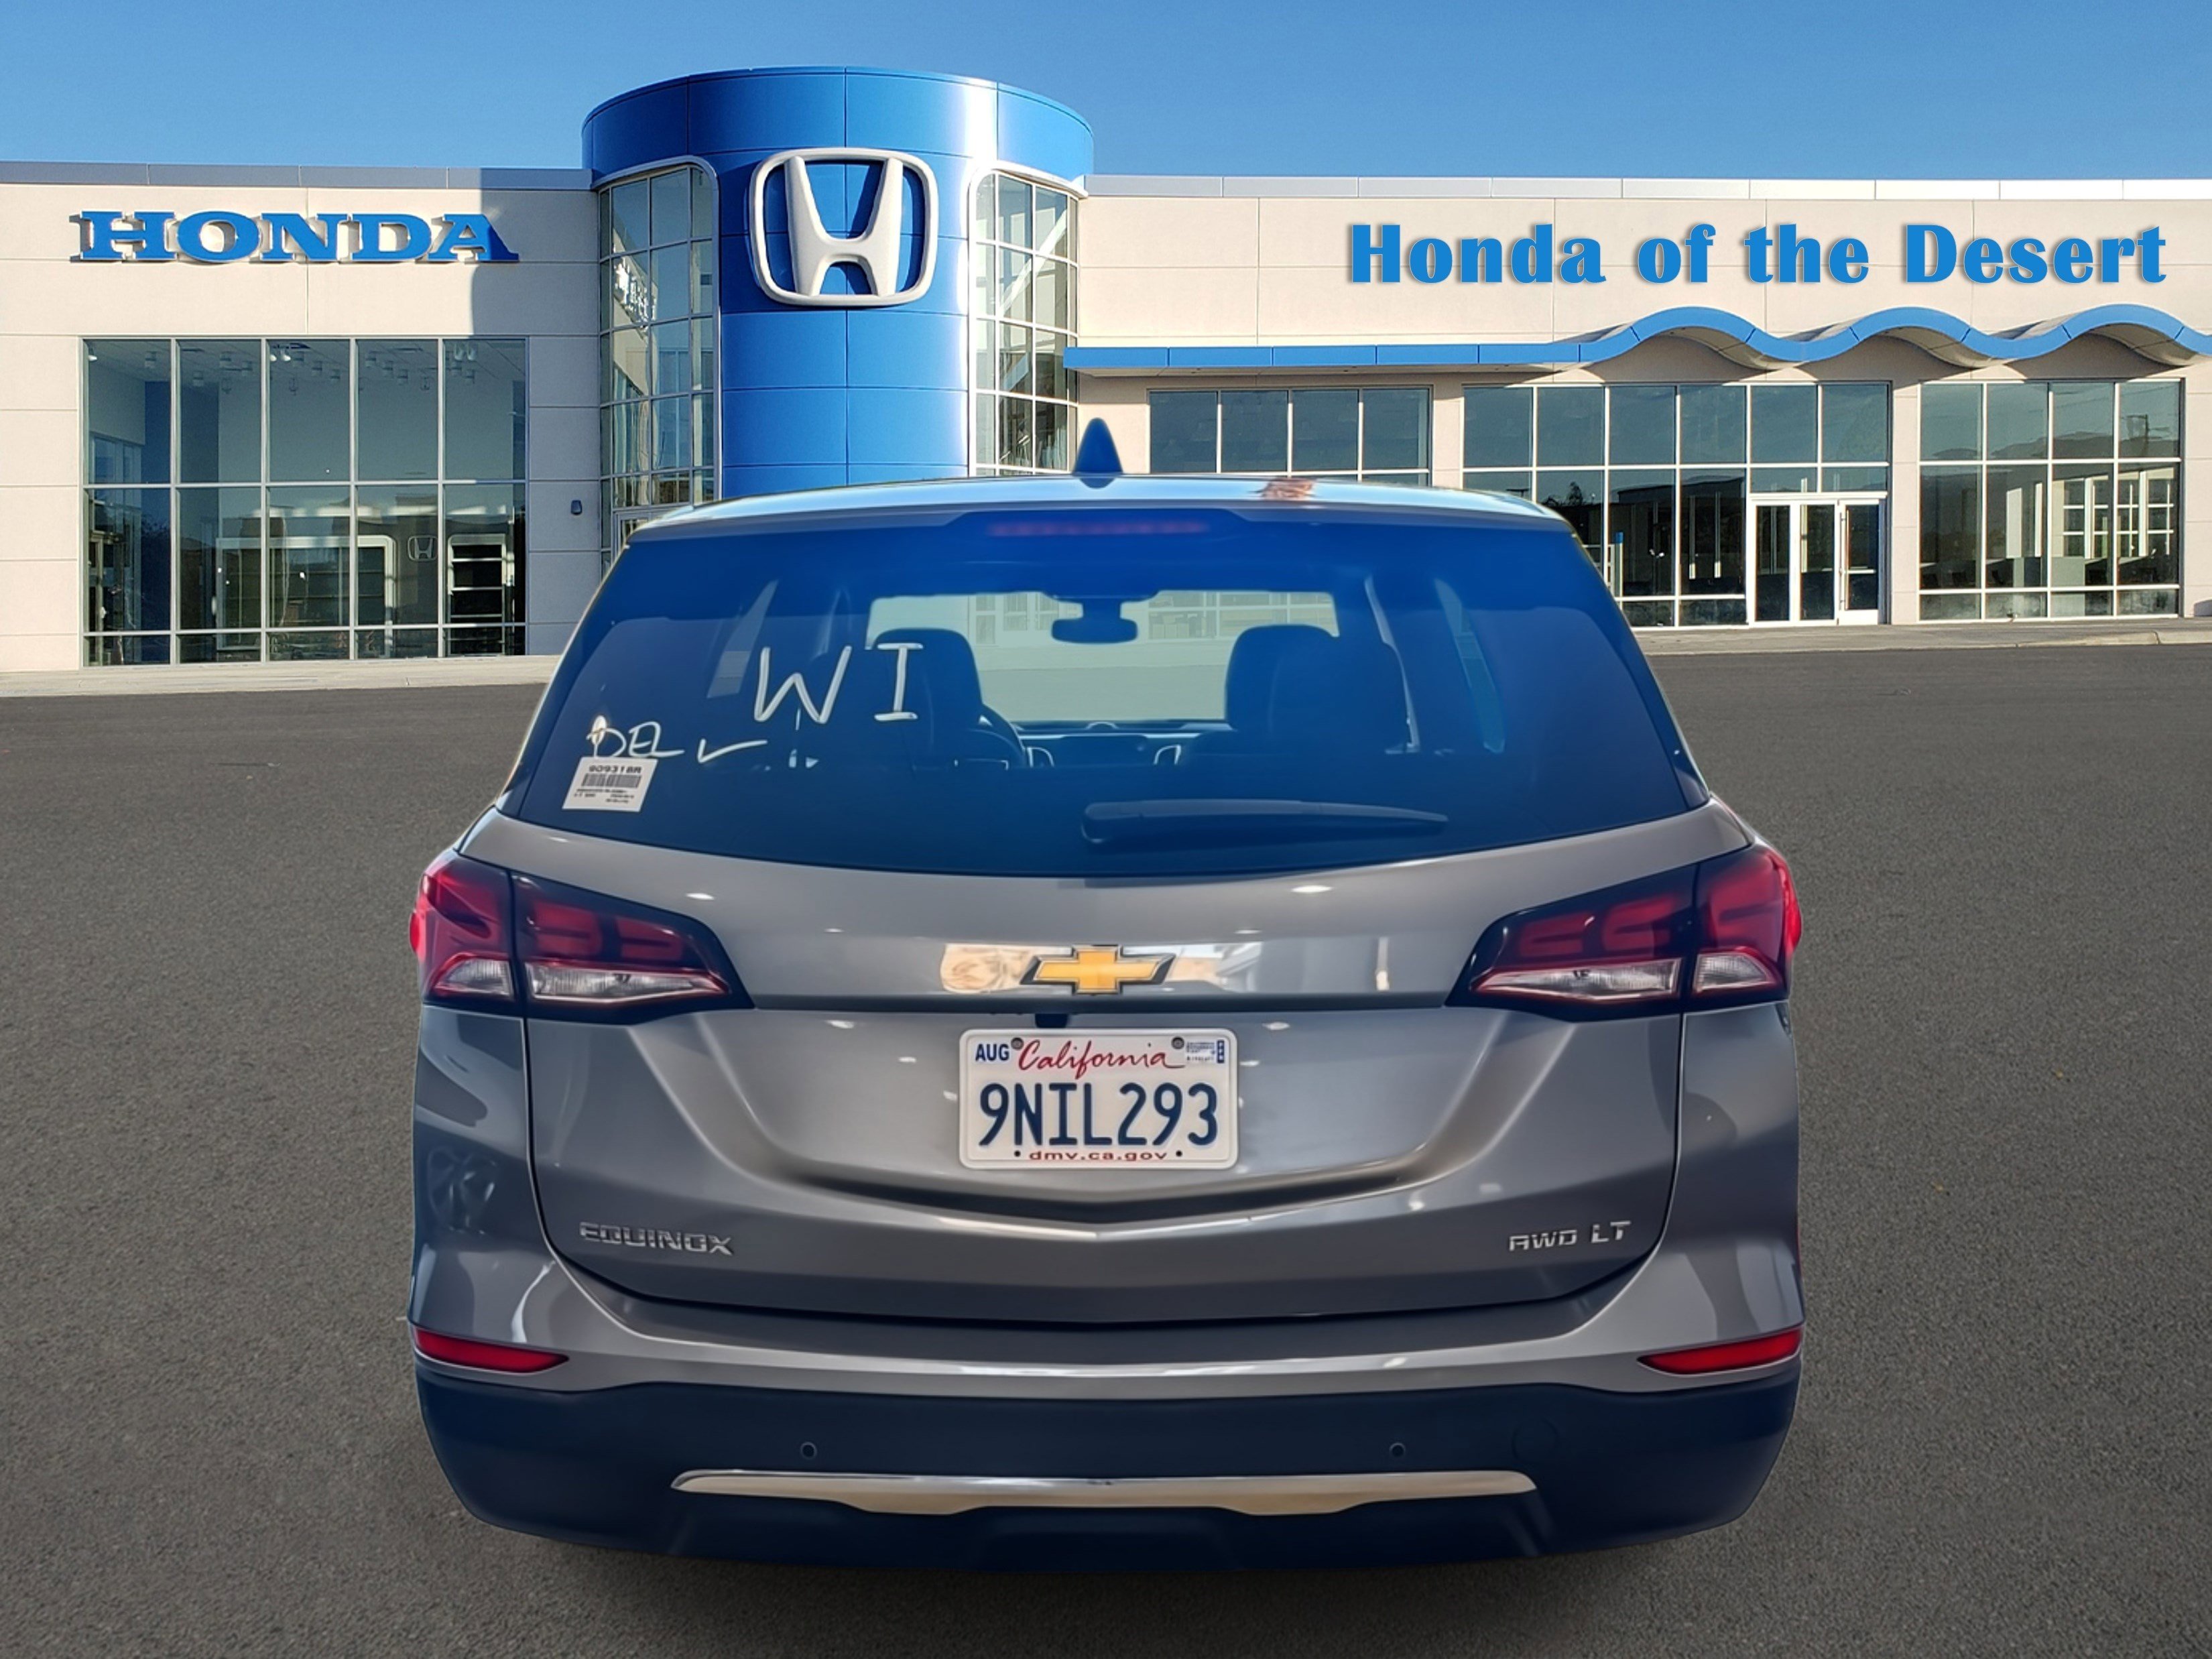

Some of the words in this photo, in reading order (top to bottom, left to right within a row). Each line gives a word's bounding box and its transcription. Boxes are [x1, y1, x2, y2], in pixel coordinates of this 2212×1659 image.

[79, 210, 519, 262] HONDA
[1350, 223, 1607, 284] Honda
[1637, 223, 1717, 284] of
[1743, 223, 1869, 284] the
[1905, 223, 2167, 284] Desert
[975, 1042, 1010, 1062] AUG
[1017, 1038, 1186, 1080] California
[978, 1081, 1218, 1147] 9NIL293
[1029, 1150, 1168, 1162] dmv.ca.gov
[578, 1221, 734, 1256] EQUINOX
[1509, 1229, 1578, 1251] AWD
[1591, 1219, 1632, 1244] LT
